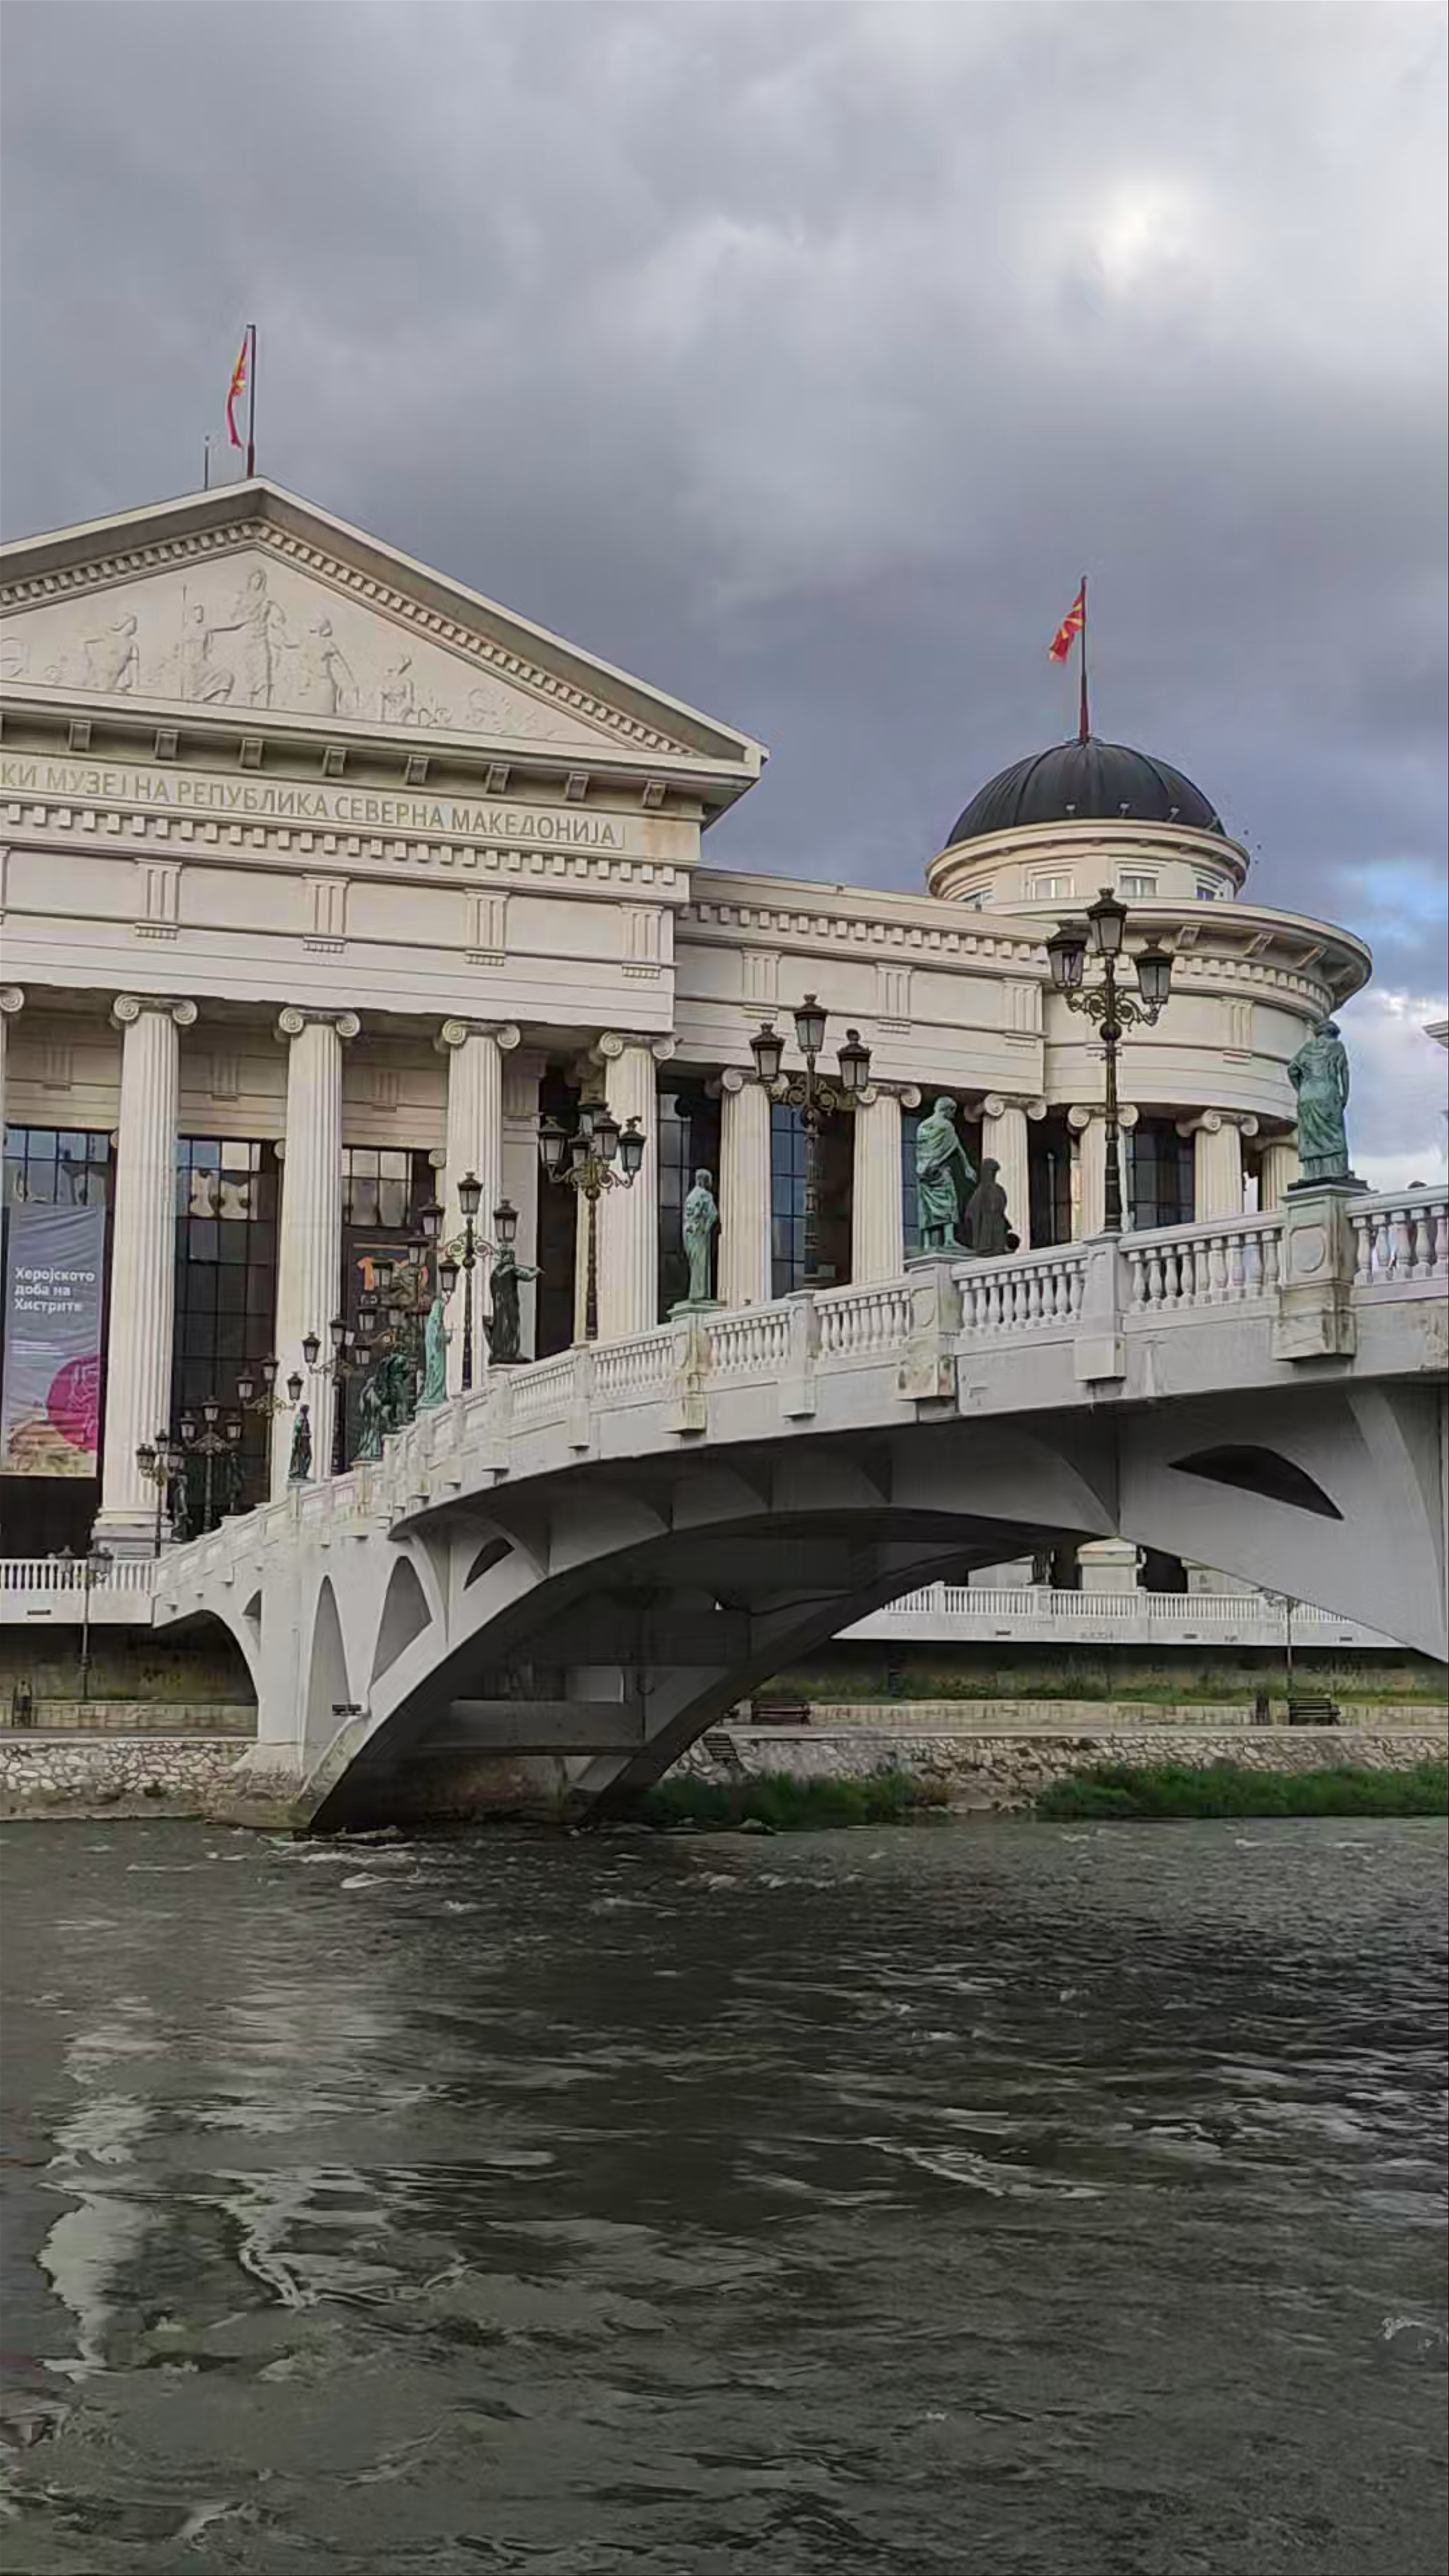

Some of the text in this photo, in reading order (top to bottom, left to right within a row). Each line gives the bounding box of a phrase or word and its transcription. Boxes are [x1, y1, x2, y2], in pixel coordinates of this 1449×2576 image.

[47, 767, 126, 796] МУЗЕЈ
[134, 774, 169, 802] НА
[176, 780, 328, 818] РЕПУБЛИКА
[334, 796, 444, 829] СЕВЕРНА
[451, 807, 616, 846] МАКЕДОНИЈА
[14, 1267, 95, 1282] Херојското
[14, 1284, 72, 1296] доба на
